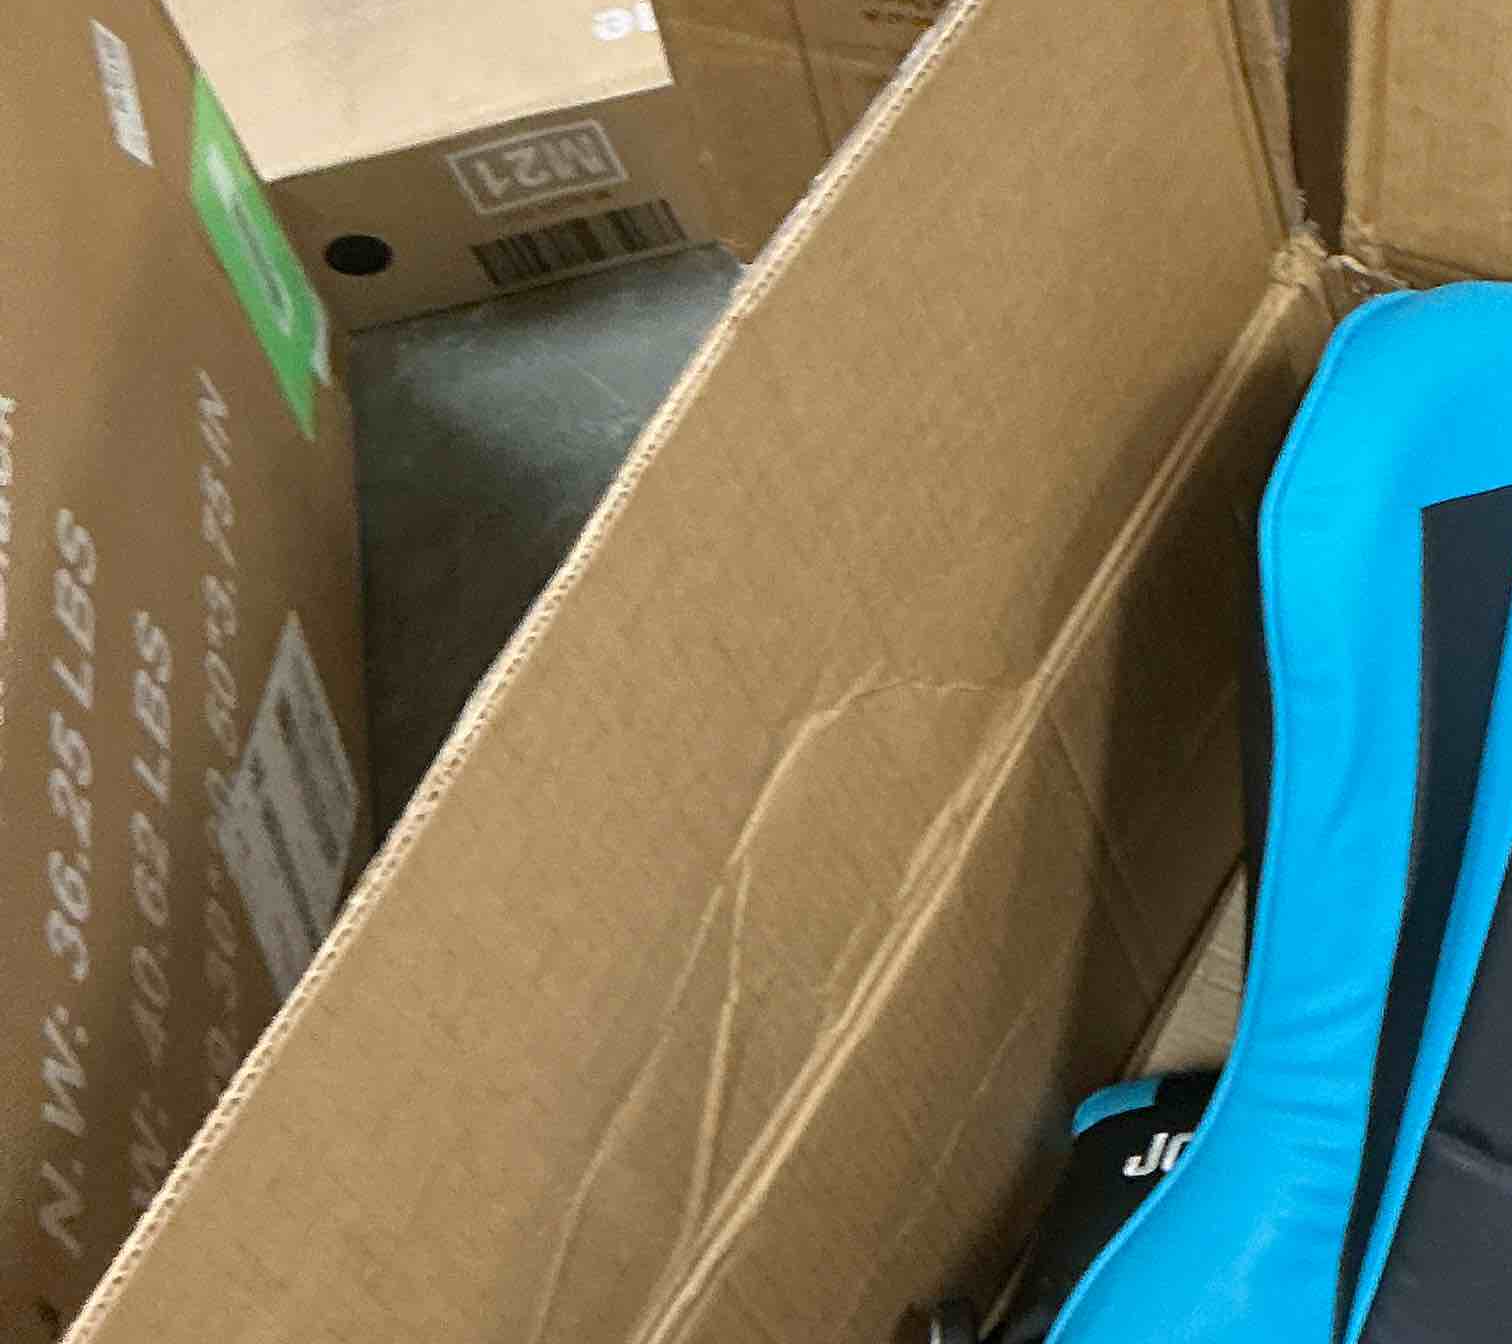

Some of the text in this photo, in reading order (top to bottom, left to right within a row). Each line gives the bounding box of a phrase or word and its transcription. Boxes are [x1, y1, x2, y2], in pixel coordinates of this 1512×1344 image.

[50, 507, 98, 710] LBS
[128, 608, 173, 804] LBS
[46, 709, 93, 984] 36.25
